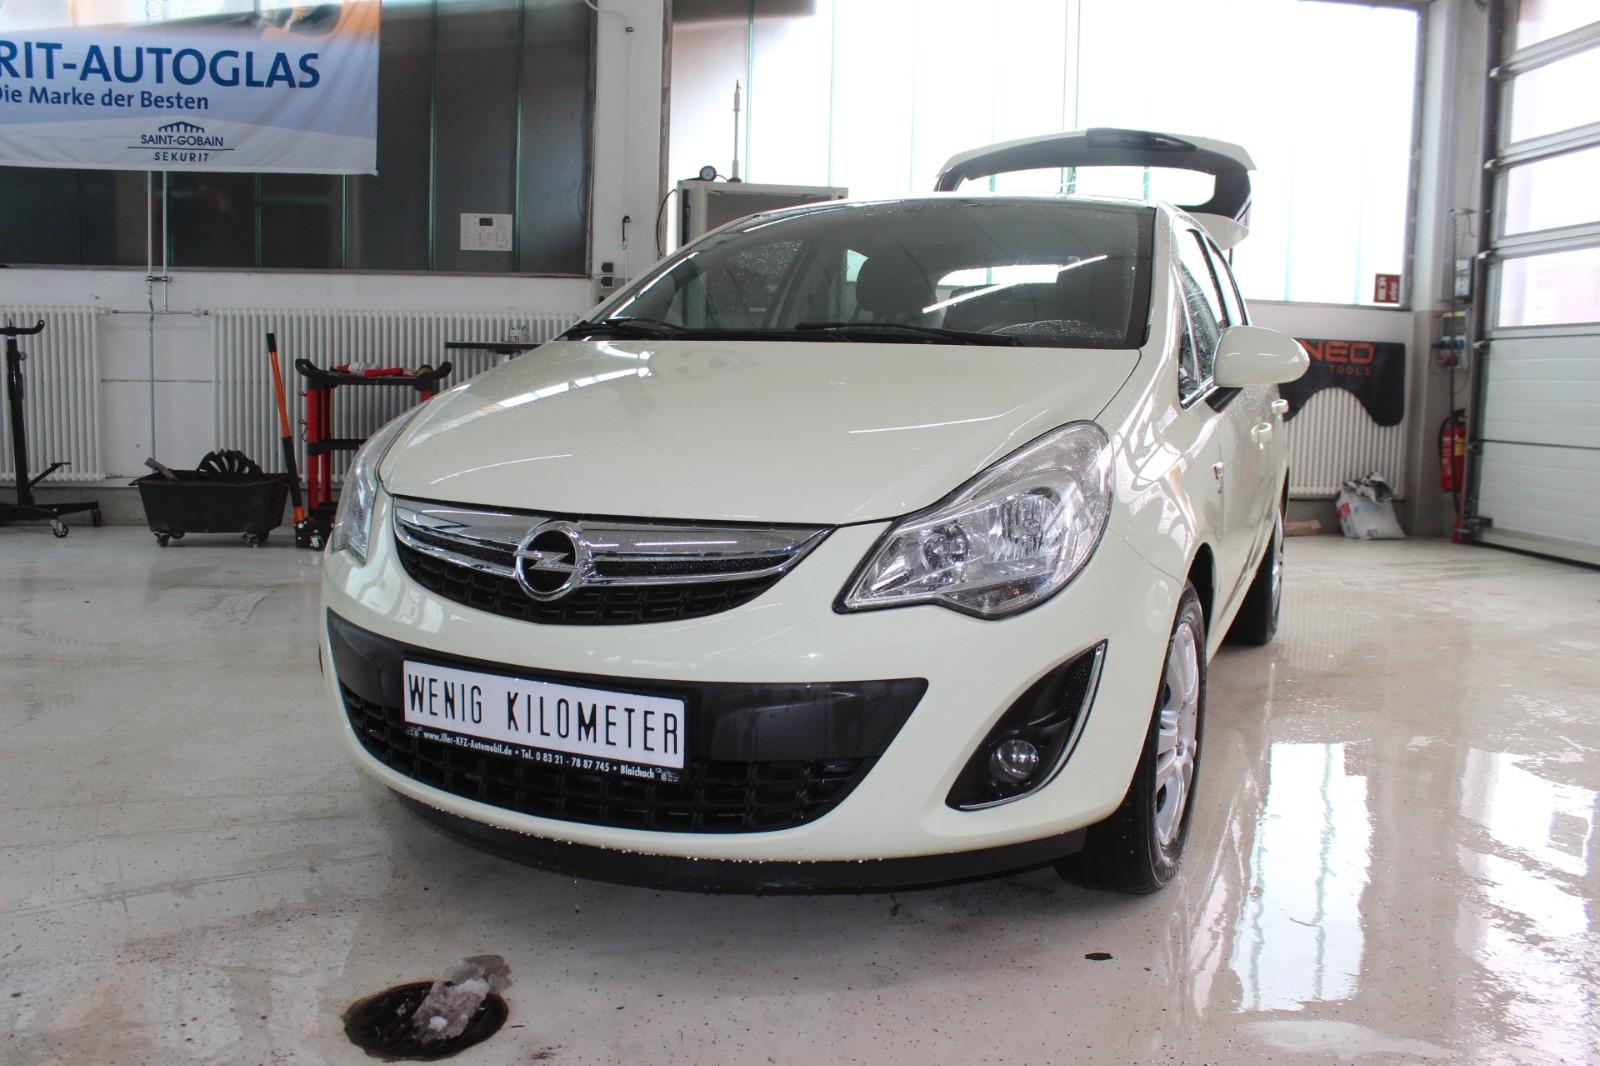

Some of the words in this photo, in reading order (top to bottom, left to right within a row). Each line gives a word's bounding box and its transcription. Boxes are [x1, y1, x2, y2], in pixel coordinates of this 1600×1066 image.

[0, 84, 23, 103] ie
[29, 86, 95, 106] Marke
[100, 88, 133, 108] der
[140, 90, 209, 110] Besten
[140, 134, 224, 147] SAINT-GOBAIN
[154, 151, 210, 162] SEKURIT
[1328, 365, 1372, 376] TOOLS
[408, 674, 482, 724] WENIG
[507, 690, 678, 755] KILOMETER
[521, 749, 534, 760] Tel.
[542, 754, 553, 763] 83
[554, 756, 564, 764] 21
[571, 757, 581, 767] 78
[582, 759, 593, 769] 87
[595, 761, 610, 772] 745
[620, 764, 655, 779] Blaichach
